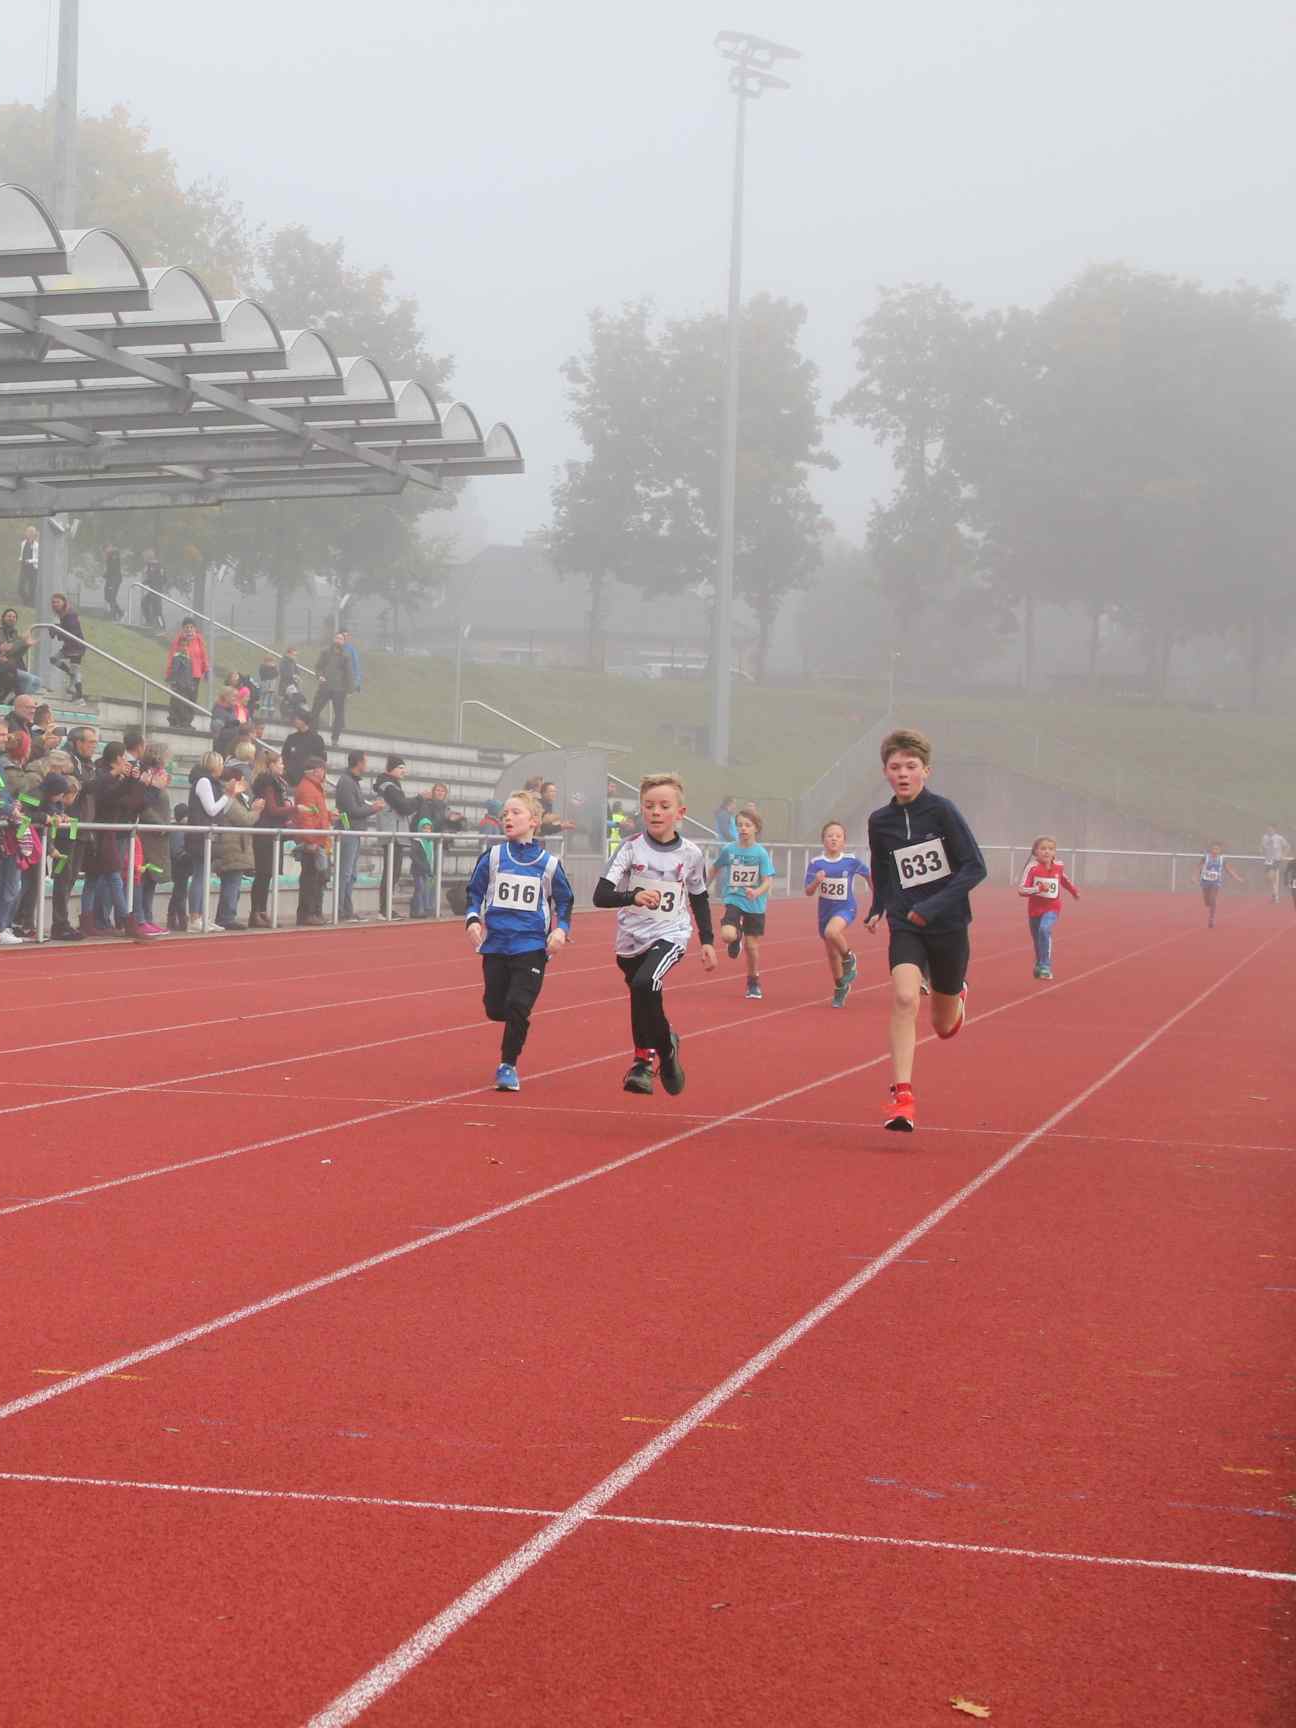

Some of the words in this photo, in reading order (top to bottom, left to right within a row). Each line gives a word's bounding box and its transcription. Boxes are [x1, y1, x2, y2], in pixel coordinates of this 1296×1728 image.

[901, 850, 942, 879] 633
[732, 870, 757, 883] 627
[498, 882, 536, 904] 616
[820, 882, 845, 896] 628
